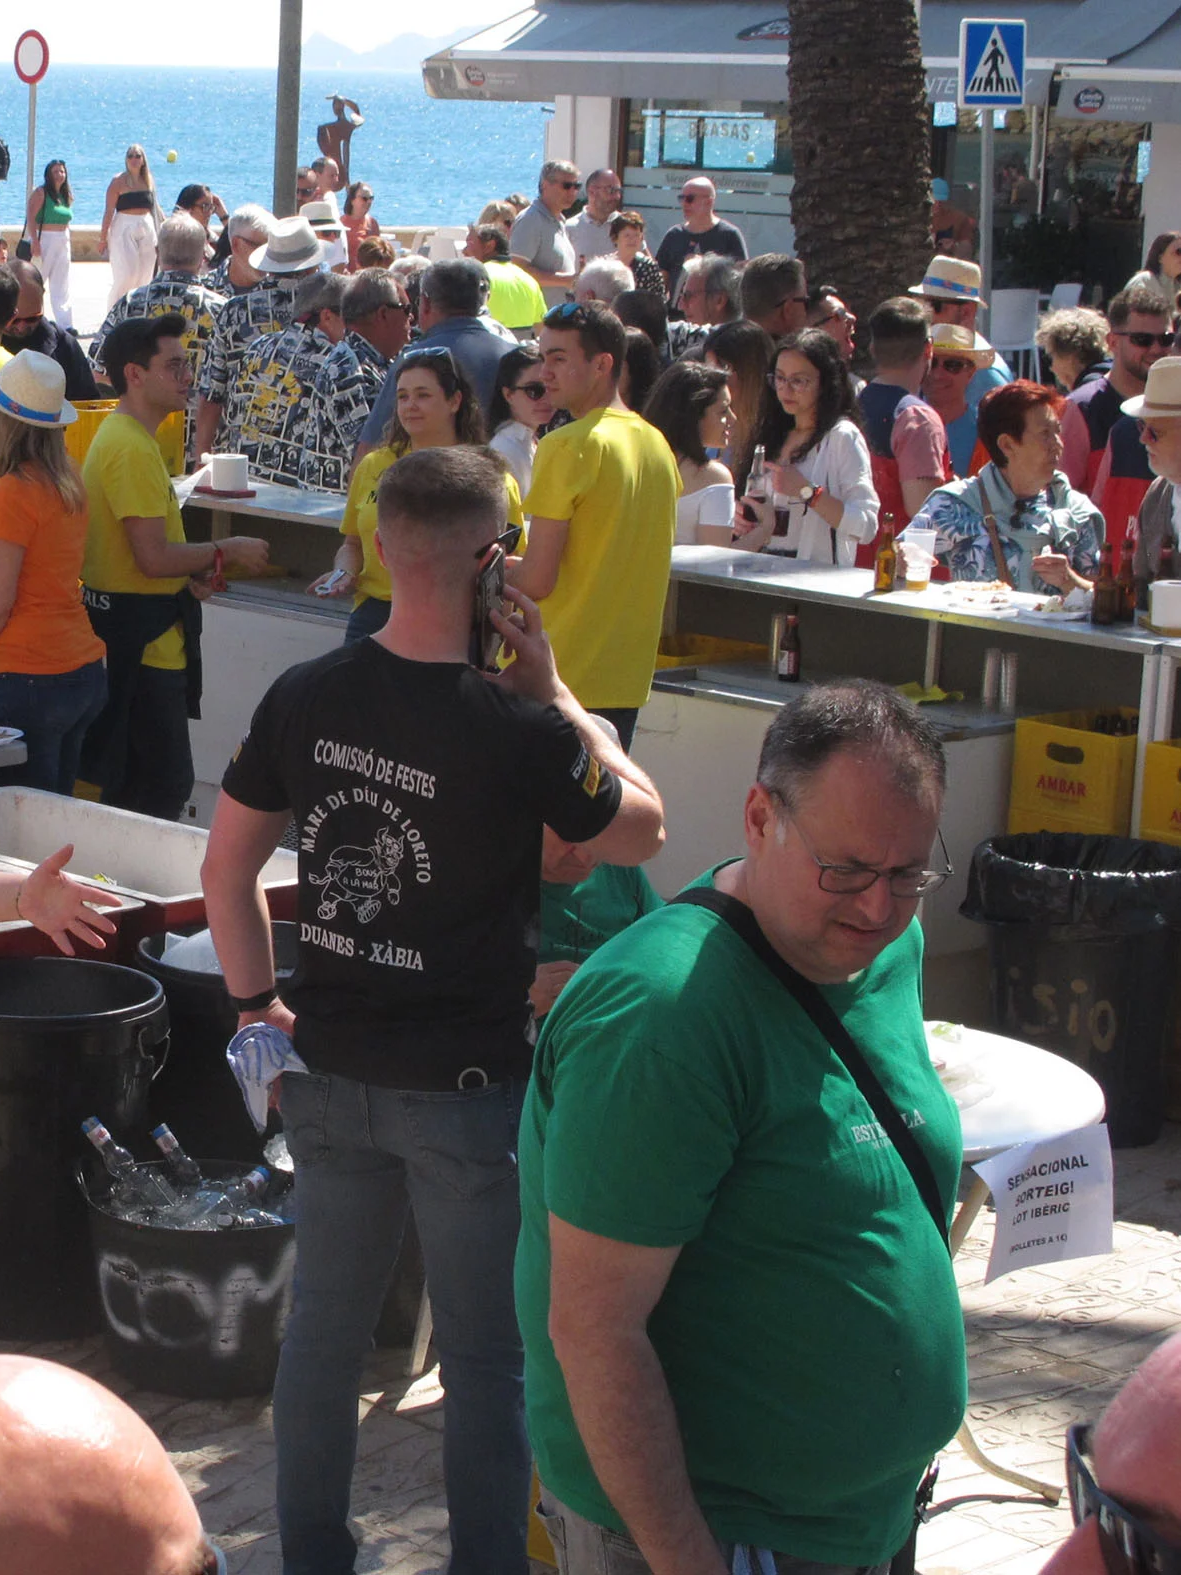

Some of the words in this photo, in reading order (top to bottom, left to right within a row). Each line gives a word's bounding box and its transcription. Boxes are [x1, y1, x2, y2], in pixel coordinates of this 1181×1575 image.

[314, 738, 374, 778] COMISSIÓ
[374, 757, 392, 785] DE
[395, 763, 436, 799] FESTES
[1036, 775, 1087, 797] AMBAR
[301, 804, 328, 853] MARE
[325, 789, 349, 810] DE
[382, 797, 403, 822] DE
[400, 818, 431, 884] LORETO
[355, 867, 377, 877] BOUS
[300, 922, 355, 957] DUANES
[369, 939, 424, 971] XÀBIA
[1007, 1154, 1089, 1191] SENSACIONAL
[1015, 1180, 1074, 1207] SORTEIG!
[1012, 1210, 1028, 1226] LOT
[1047, 1236, 1054, 1244] A
